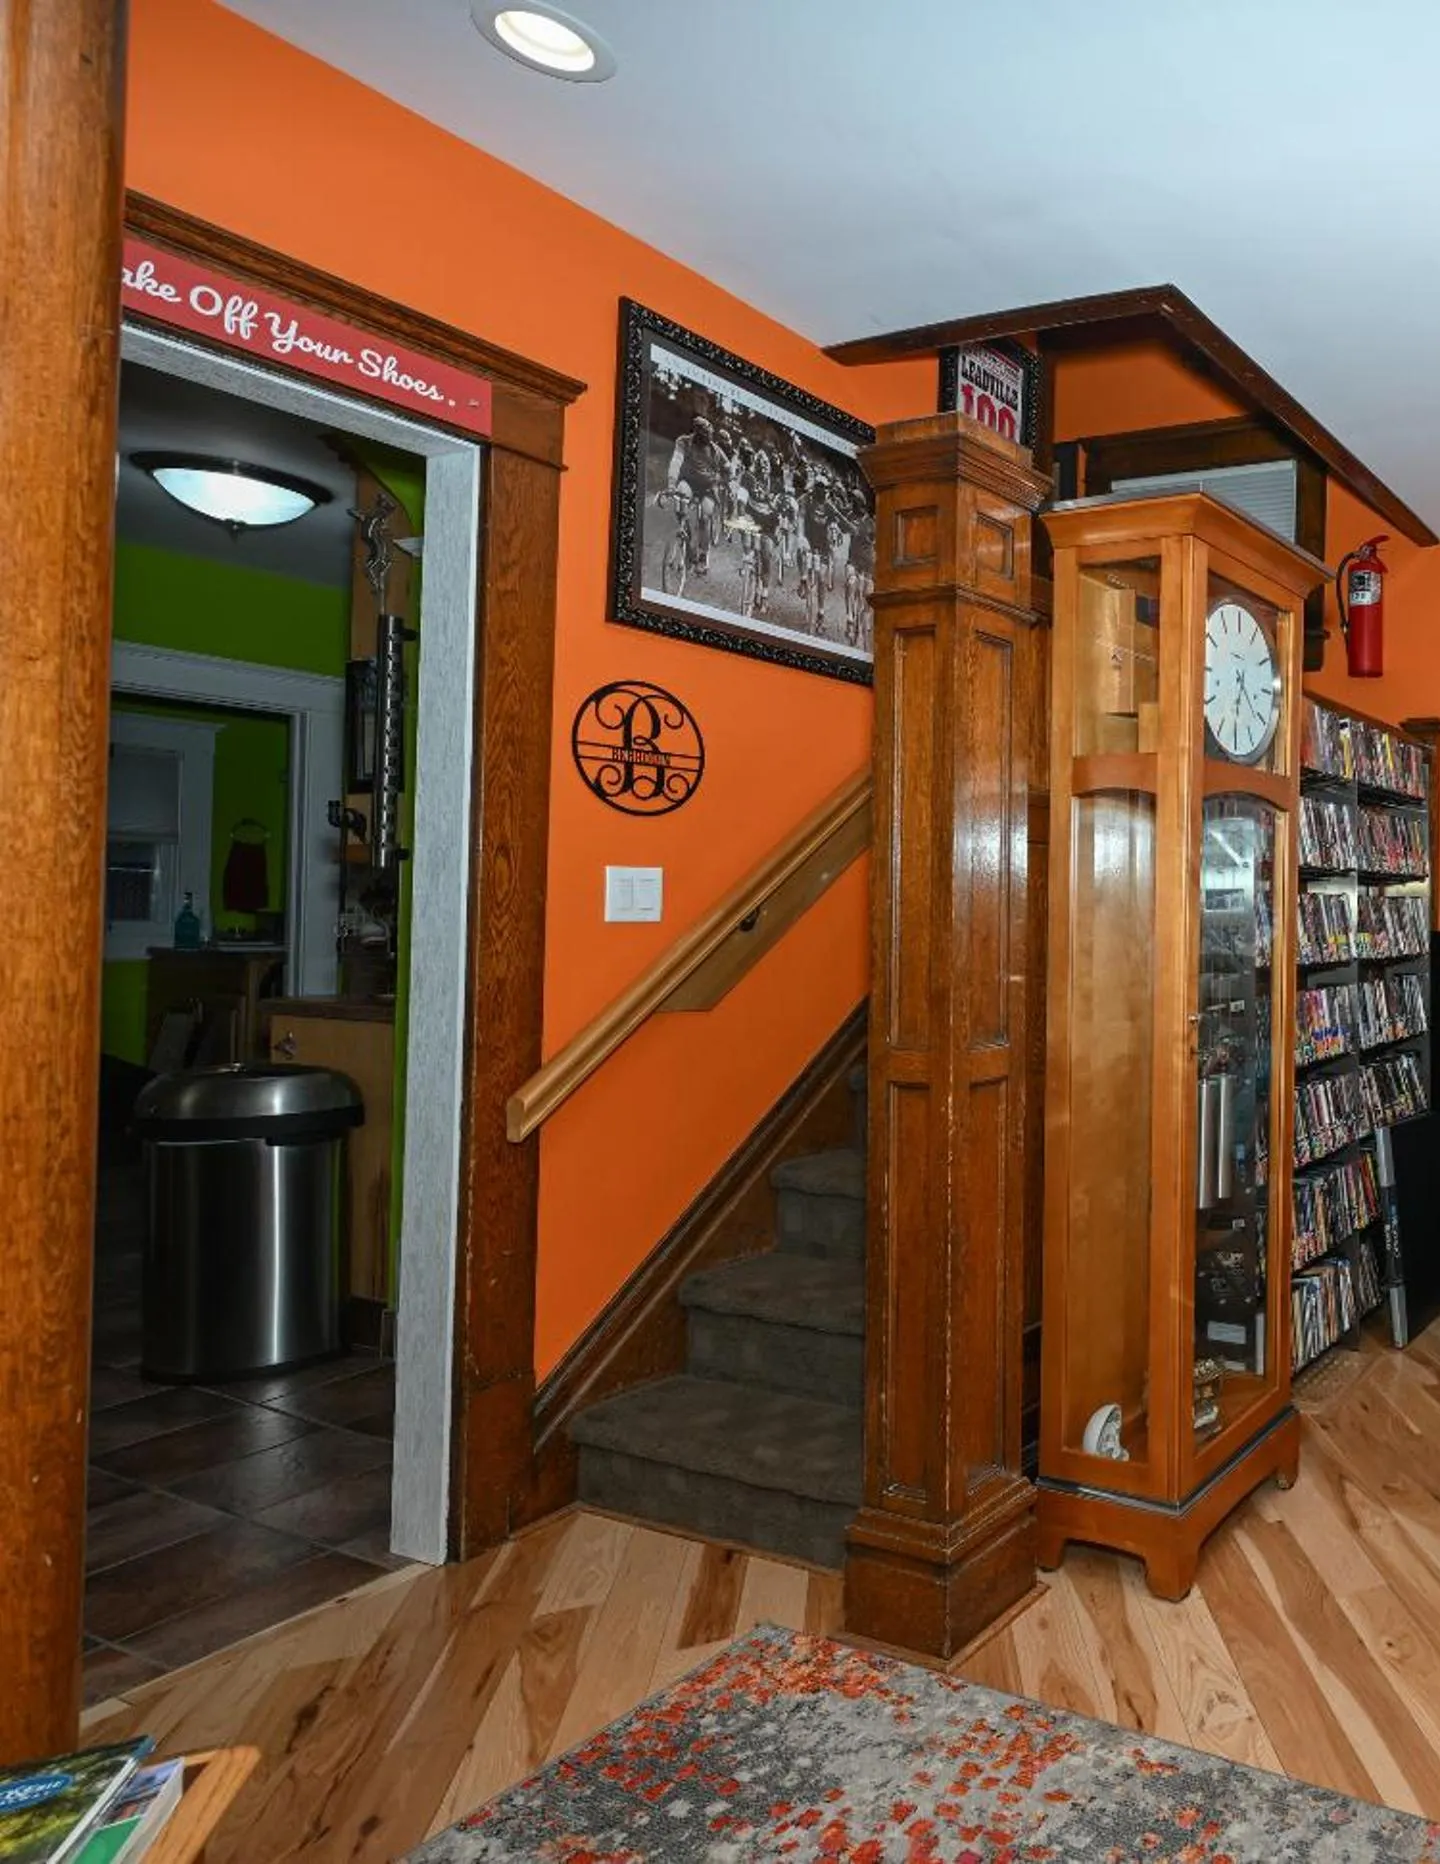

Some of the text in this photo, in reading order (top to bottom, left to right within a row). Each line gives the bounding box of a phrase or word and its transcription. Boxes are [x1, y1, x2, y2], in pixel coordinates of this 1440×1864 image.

[122, 260, 182, 302] ake
[189, 285, 259, 340] Off
[264, 311, 354, 365] Your
[961, 383, 1016, 441] 100
